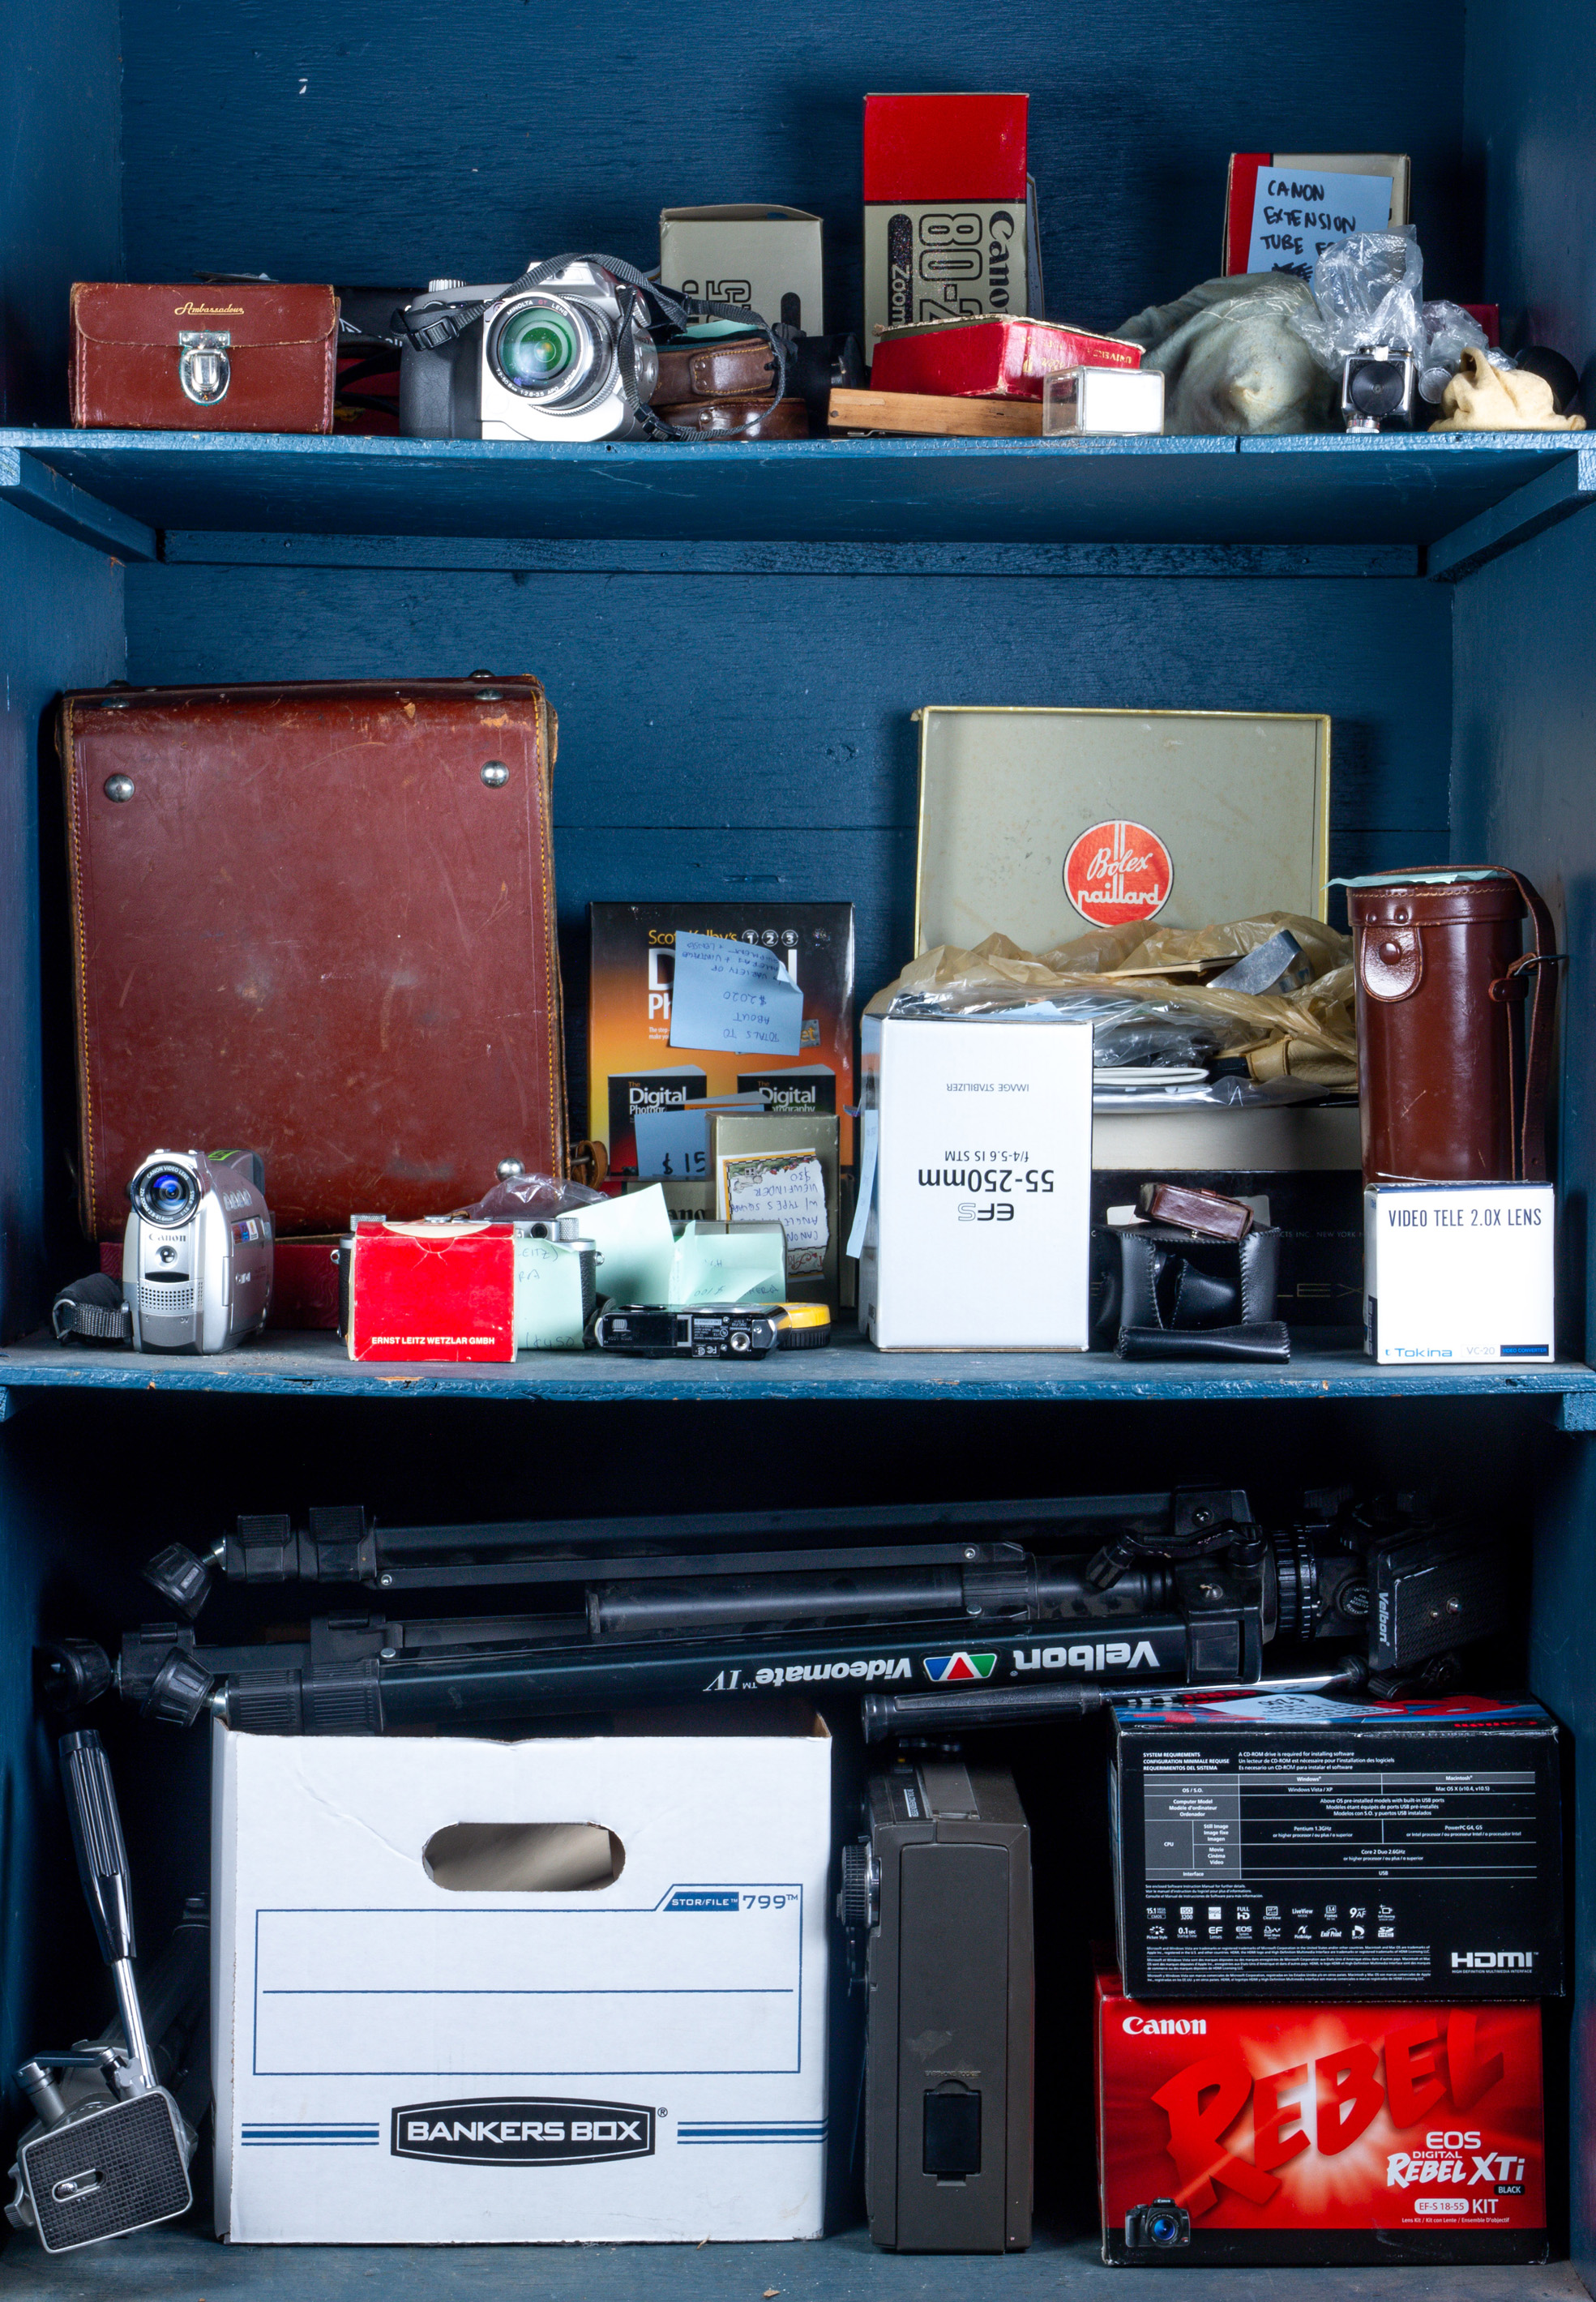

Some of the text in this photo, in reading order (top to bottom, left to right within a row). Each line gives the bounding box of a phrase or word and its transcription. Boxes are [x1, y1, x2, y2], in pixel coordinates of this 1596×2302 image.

[1268, 180, 1324, 201] CANON
[1263, 206, 1356, 233] EXTENSION
[1260, 234, 1303, 255] TUBE
[918, 213, 983, 321] 80-2
[989, 211, 1015, 314] Cano
[507, 300, 533, 316] MINOLTA
[551, 303, 569, 317] LENS
[547, 386, 559, 395] APO
[1087, 847, 1153, 881] Bolex
[1078, 882, 1162, 909] paillard
[648, 930, 676, 944] Scot
[729, 967, 768, 980] VARIETY
[723, 991, 767, 1005] $2020
[733, 1012, 770, 1025] ABOUT
[723, 1029, 780, 1042] TOTALS TO
[946, 1083, 1029, 1092] IMAGE STABILIZER
[629, 1086, 687, 1106] Digital
[629, 1104, 666, 1116] Photogr
[662, 1152, 673, 1175] $
[944, 1150, 1029, 1162] f/4-5.6 IS STM
[147, 1166, 164, 1179] CANON
[178, 1169, 190, 1180] LENS
[790, 1166, 811, 1183] $30
[918, 1169, 1055, 1192] 55-250mm
[753, 1183, 818, 1197] VIEWFINDER
[141, 1197, 150, 1213] ZOOM
[1388, 1208, 1542, 1227] VIDEO TELE 2.0X LENS
[148, 1233, 186, 1242] Canon
[786, 1231, 819, 1241] CANON
[371, 1336, 495, 1345] ERNST LEITZ WETZLAR GMBH
[1394, 1348, 1453, 1358] Tokina
[1465, 1346, 1495, 1355] VC-20
[703, 1670, 740, 1692] IV
[1236, 1912, 1251, 1920] HD
[1209, 1926, 1222, 1935] EF
[1122, 2016, 1206, 2035] Canon
[1151, 2009, 1504, 2219] REBEL
[407, 2120, 642, 2143] BANKERS BOX
[1426, 2131, 1482, 2150] EOS
[1412, 2150, 1462, 2159] DIGITAL
[1387, 2152, 1525, 2189] REBEL XTi
[1418, 2198, 1499, 2214] EF-S 18-55 KIT
